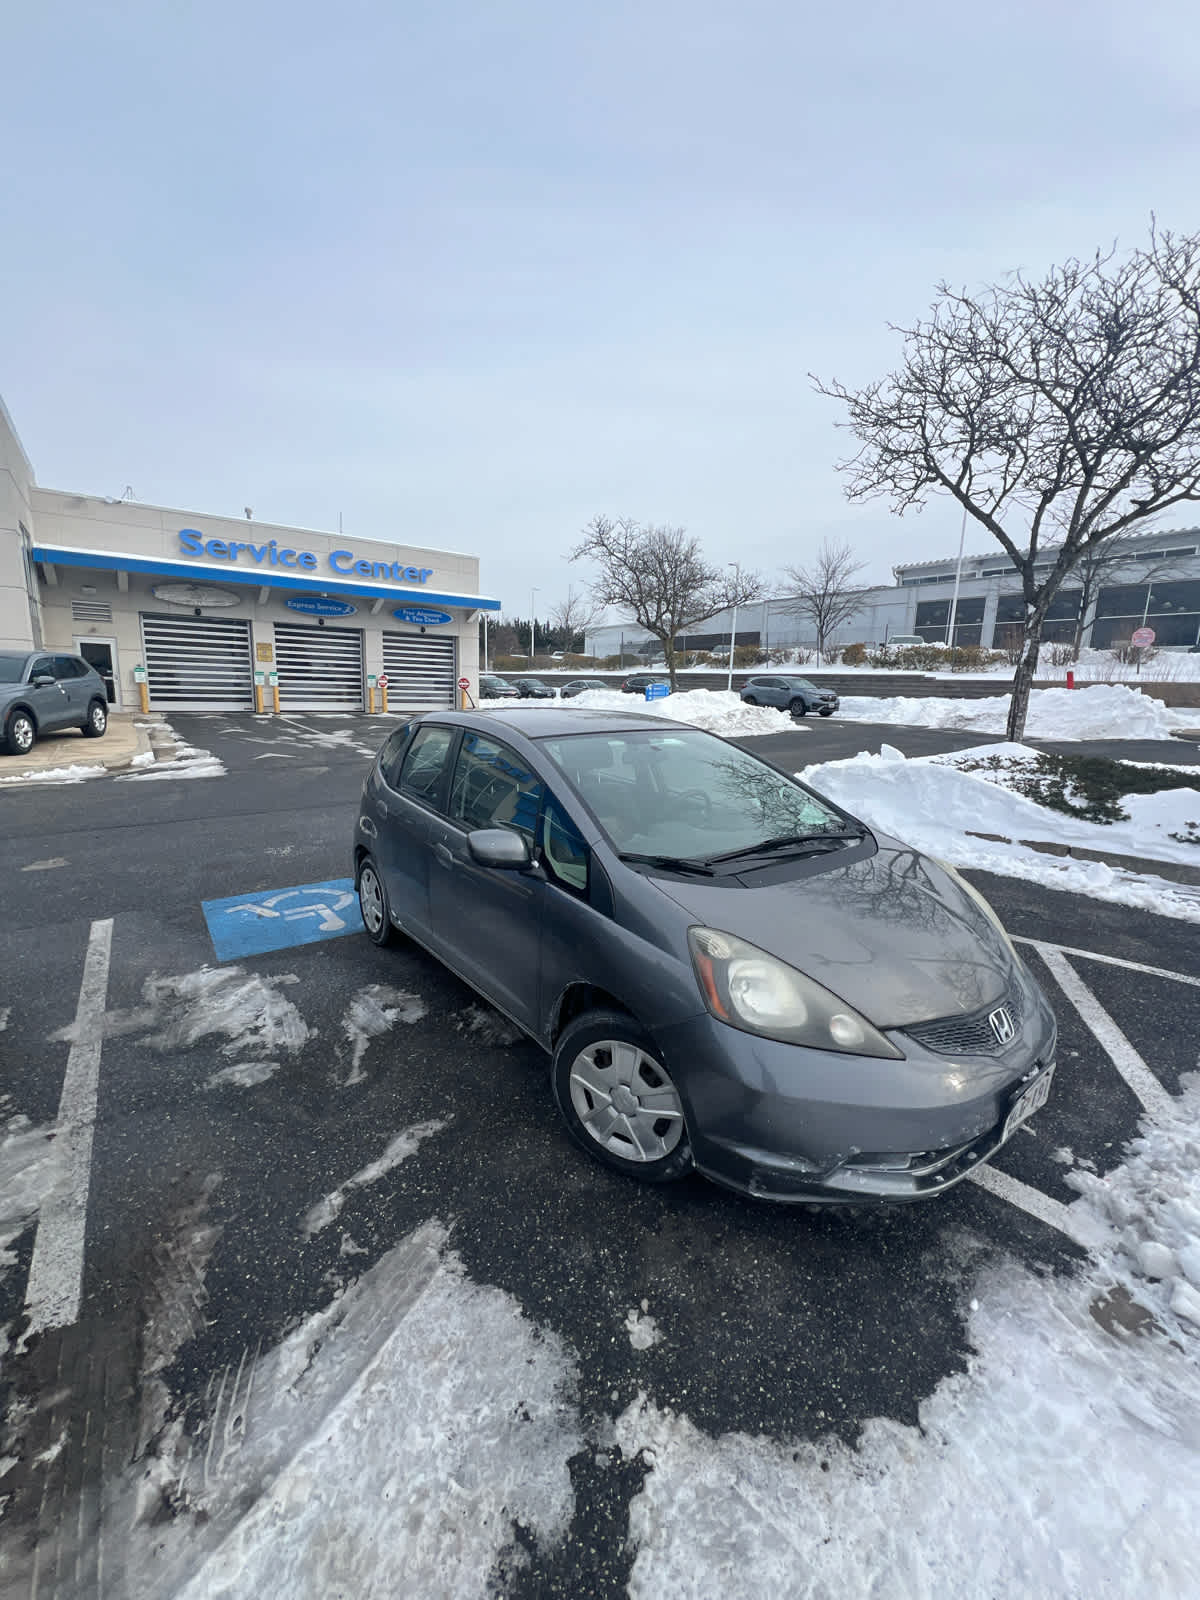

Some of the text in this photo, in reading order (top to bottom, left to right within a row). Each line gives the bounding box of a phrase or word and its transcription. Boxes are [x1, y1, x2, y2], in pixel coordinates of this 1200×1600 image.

[178, 528, 433, 584] Service Center
[287, 600, 342, 612] Express Service
